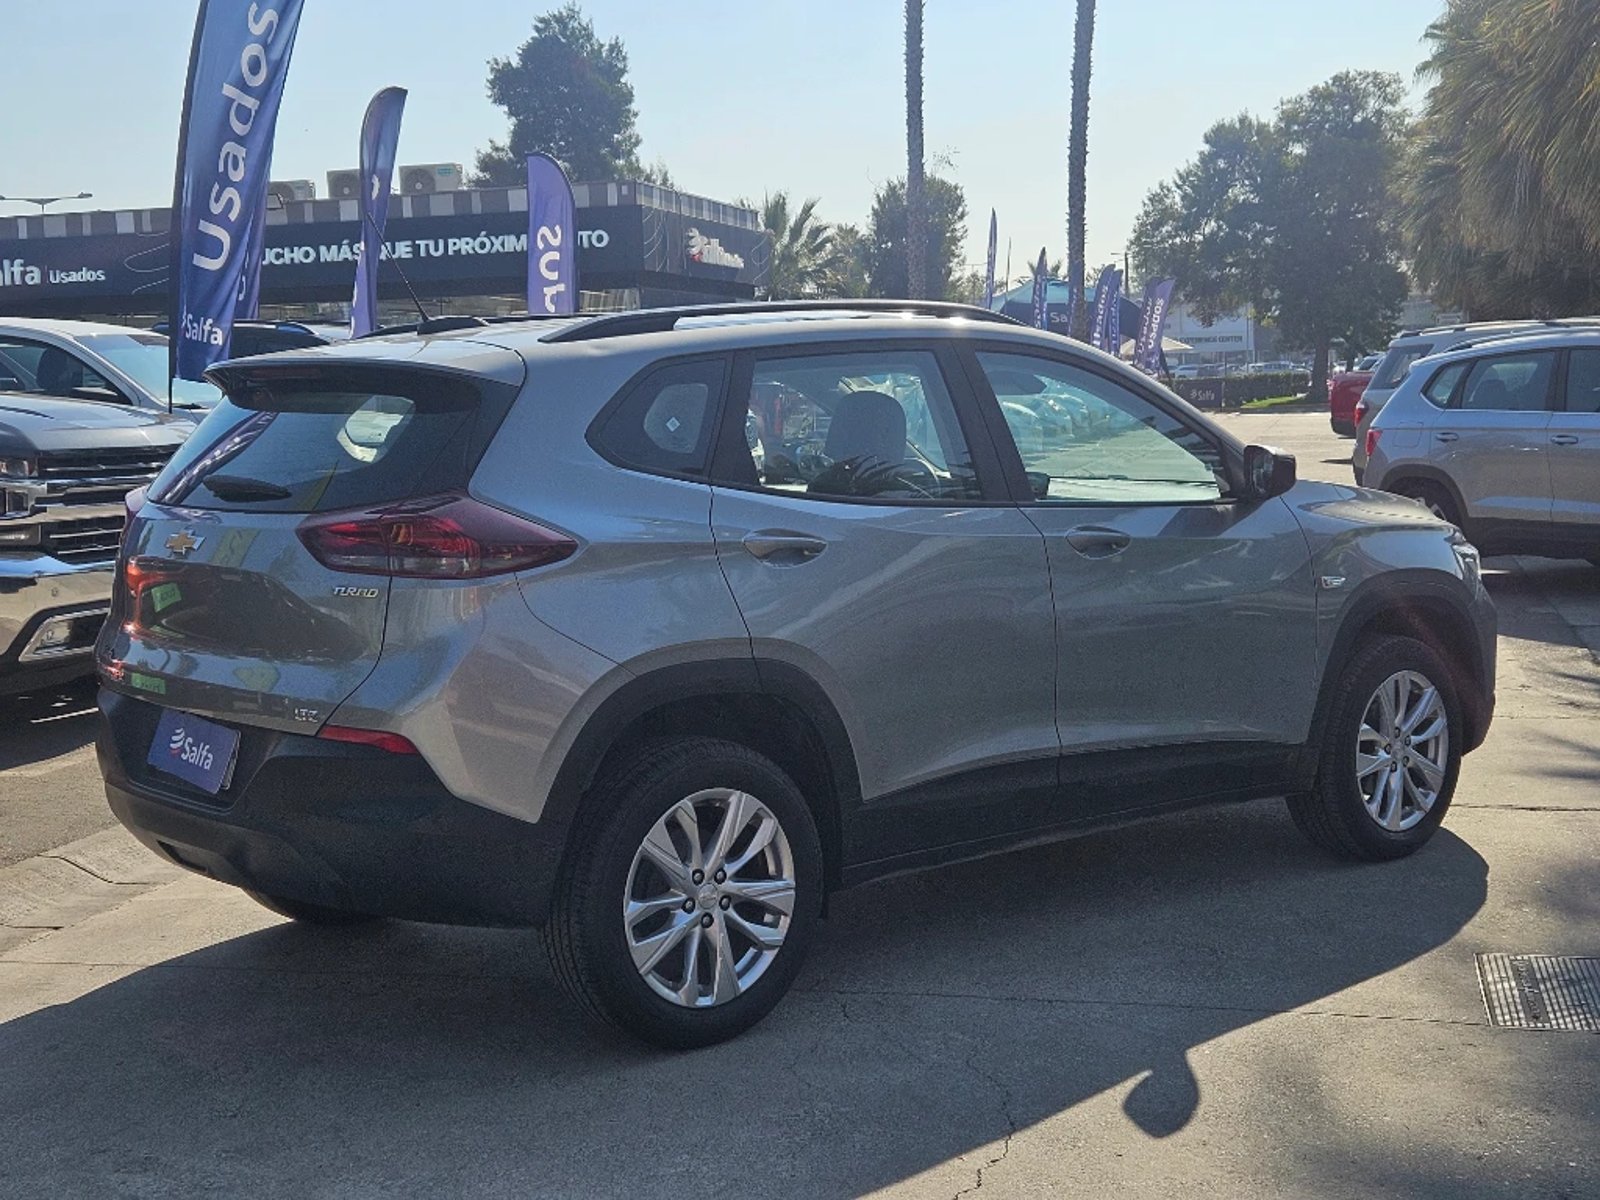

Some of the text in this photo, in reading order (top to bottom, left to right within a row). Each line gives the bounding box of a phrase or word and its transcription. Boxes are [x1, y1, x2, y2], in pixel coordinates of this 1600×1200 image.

[193, 2, 278, 271] Usados
[415, 239, 444, 257] TU
[448, 231, 527, 256] PRÓXIM
[184, 312, 223, 346] Salfa
[181, 737, 214, 770] Salfa
